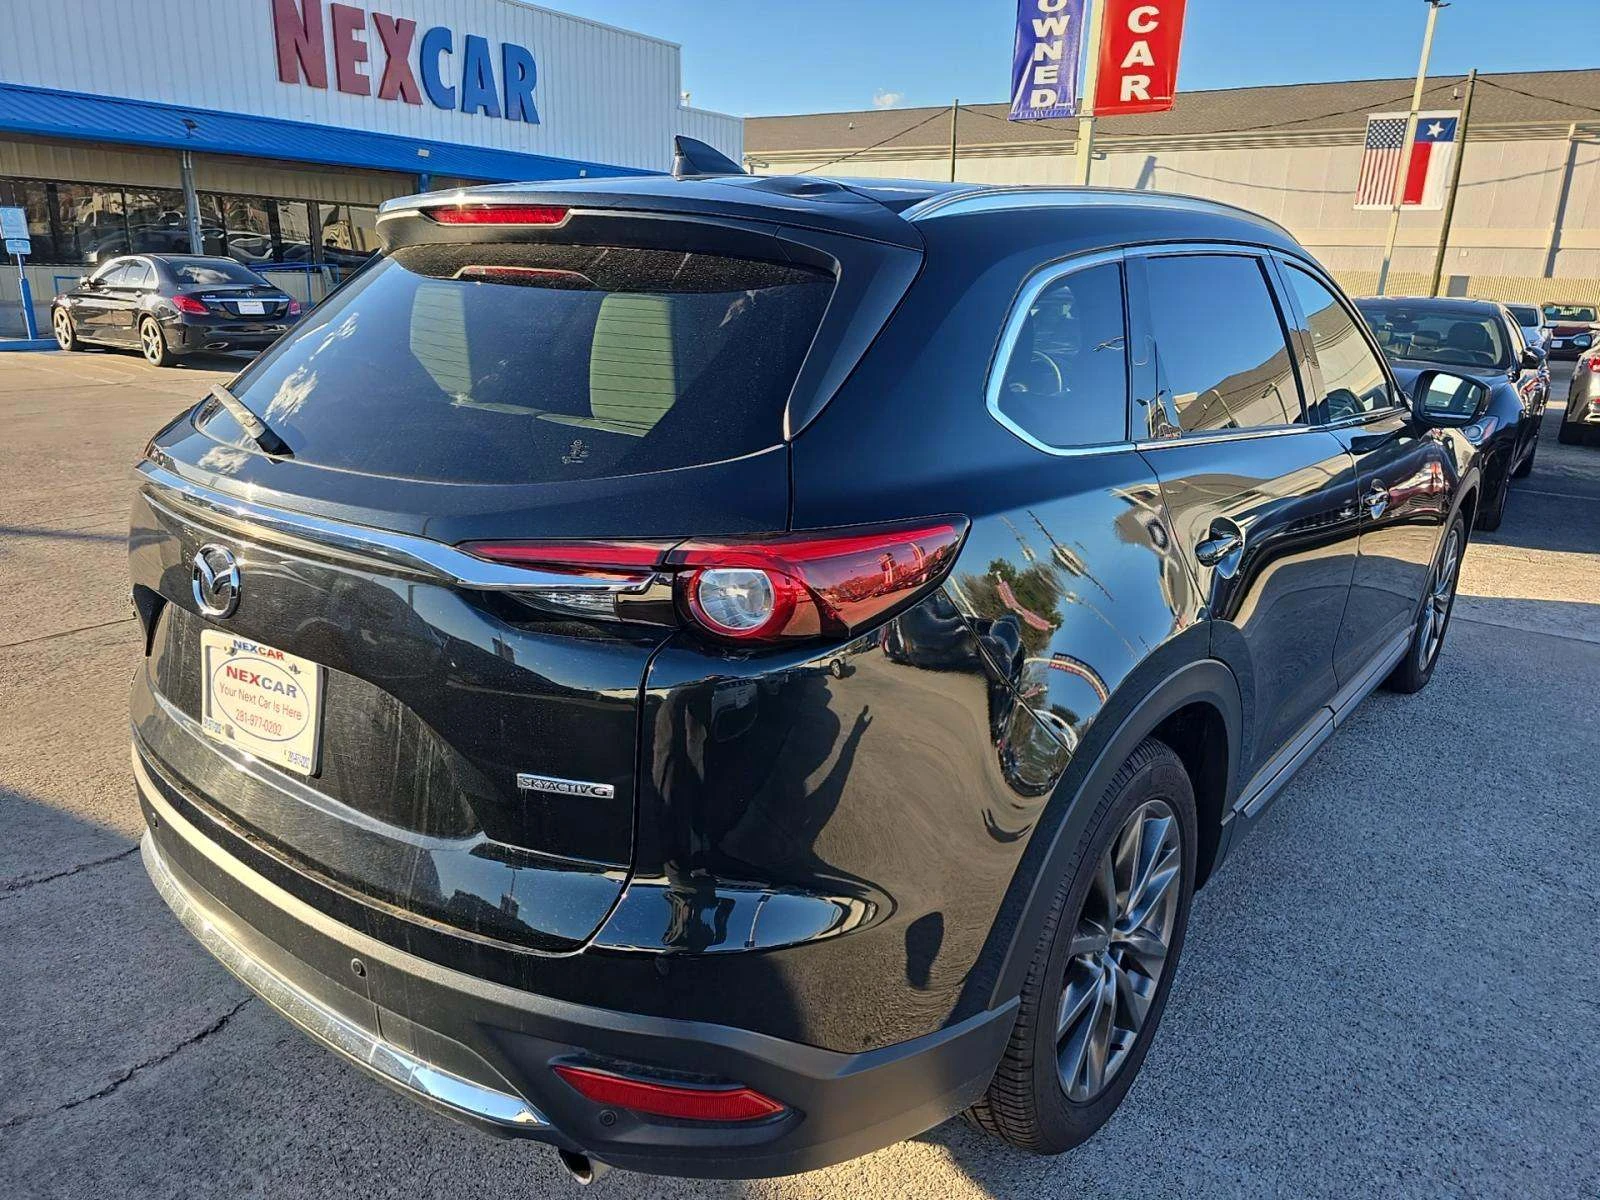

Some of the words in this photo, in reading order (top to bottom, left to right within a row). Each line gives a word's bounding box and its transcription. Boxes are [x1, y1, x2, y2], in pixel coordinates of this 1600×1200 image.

[271, 0, 540, 125] NEXCAR
[1120, 5, 1160, 102] CAR
[233, 639, 285, 661] NEXCAR
[219, 681, 238, 698] Your
[238, 689, 257, 705] Next
[257, 695, 272, 709] Car
[282, 705, 302, 721] Here
[226, 665, 297, 698] NEXCAR
